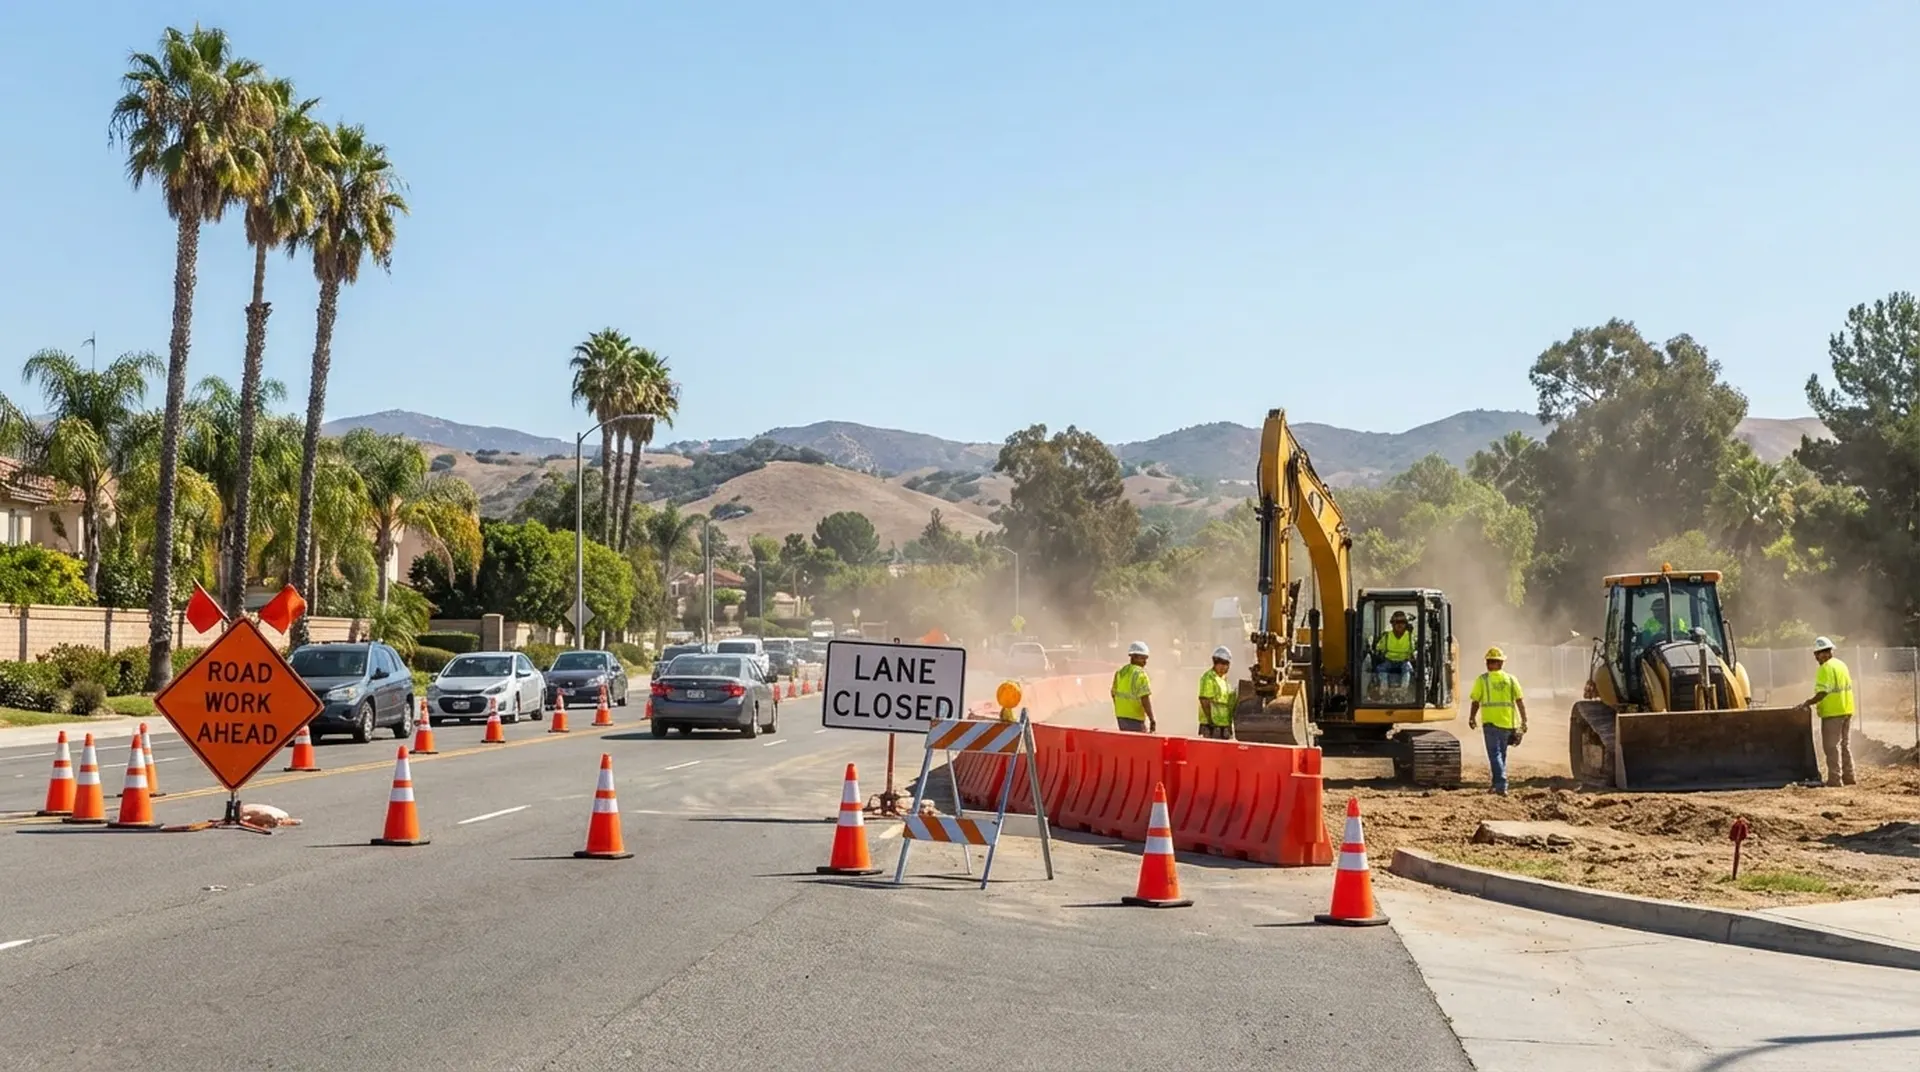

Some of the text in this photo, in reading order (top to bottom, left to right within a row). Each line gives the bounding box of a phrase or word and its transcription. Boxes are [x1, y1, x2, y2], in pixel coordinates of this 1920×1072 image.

[208, 661, 272, 683] ROAD
[855, 654, 936, 684] LANE
[205, 691, 271, 713] WORK
[833, 690, 953, 720] CLOSED
[197, 722, 277, 745] AHEAD
